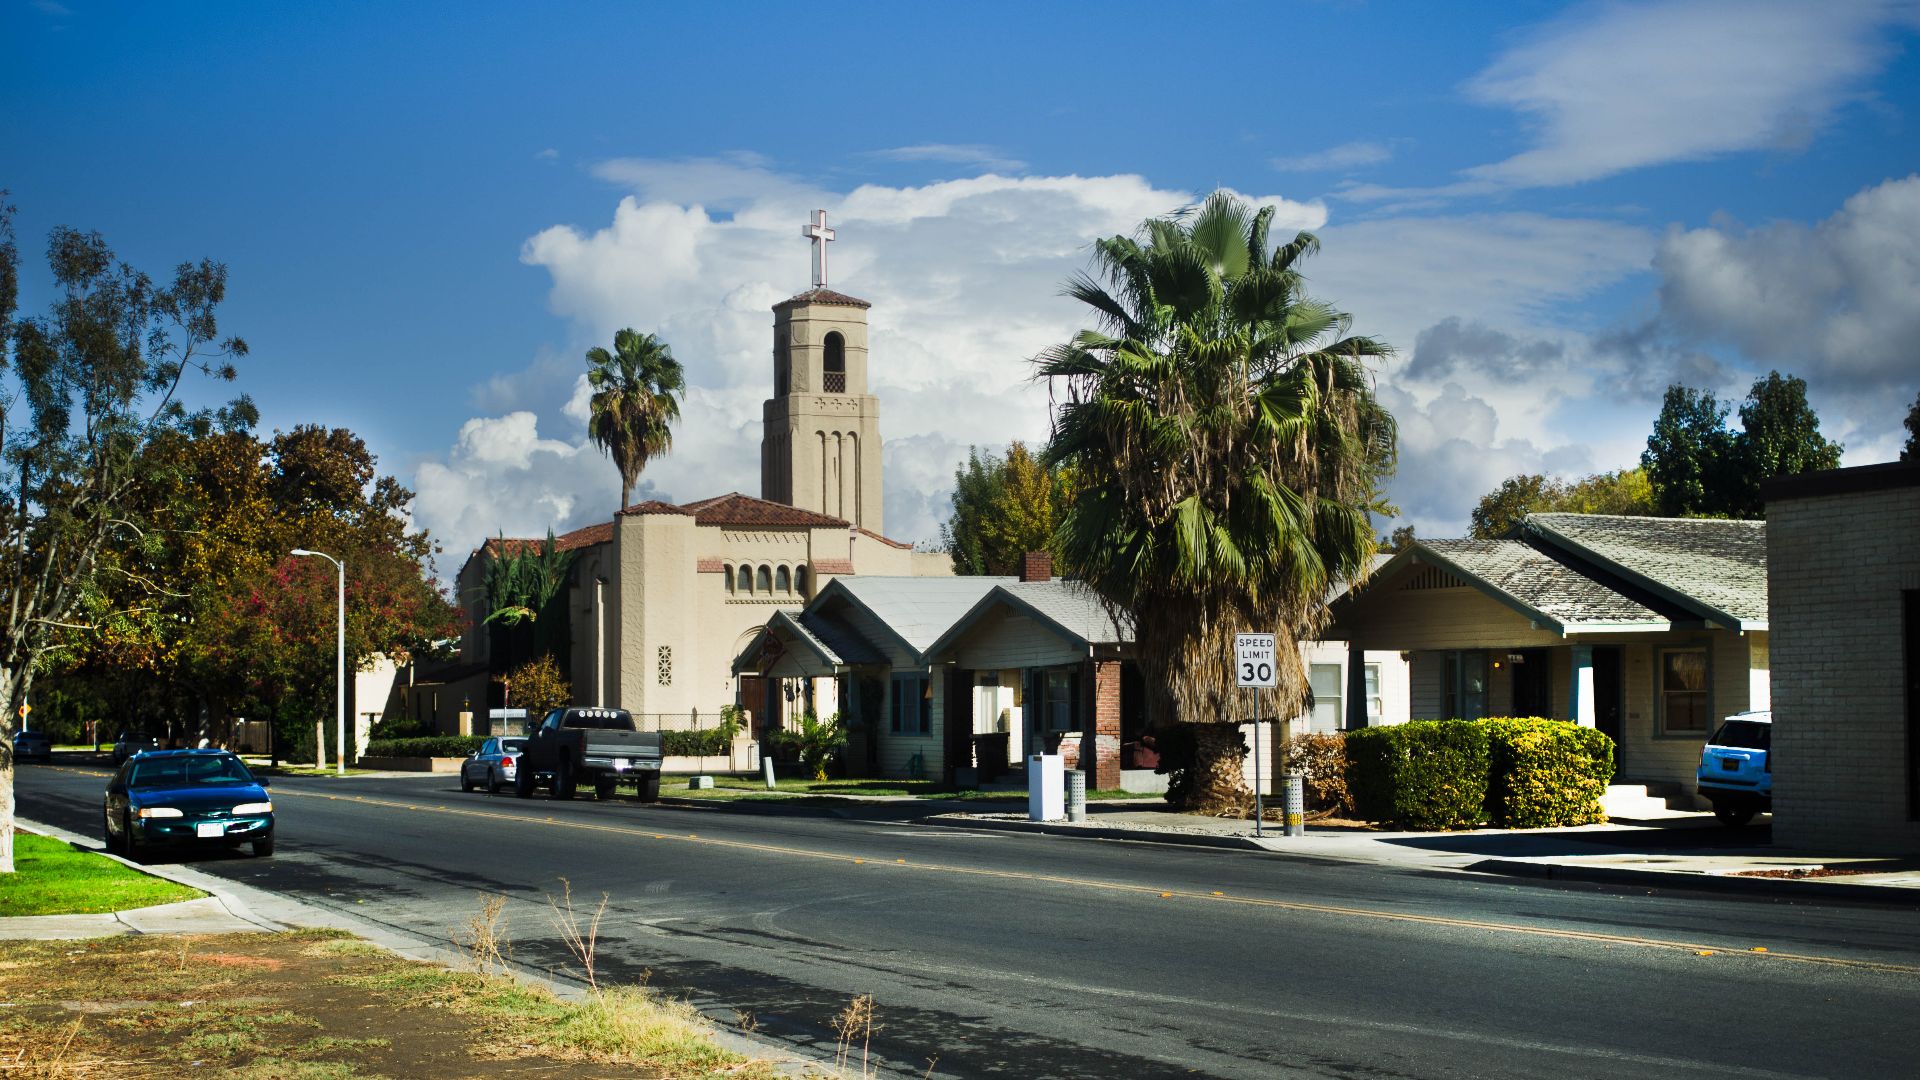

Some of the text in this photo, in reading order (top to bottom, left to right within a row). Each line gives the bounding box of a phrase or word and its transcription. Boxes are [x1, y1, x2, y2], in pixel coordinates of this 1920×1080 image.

[1239, 638, 1273, 647] SPEED
[1242, 651, 1270, 659] LIMIT
[1241, 662, 1272, 682] 30
